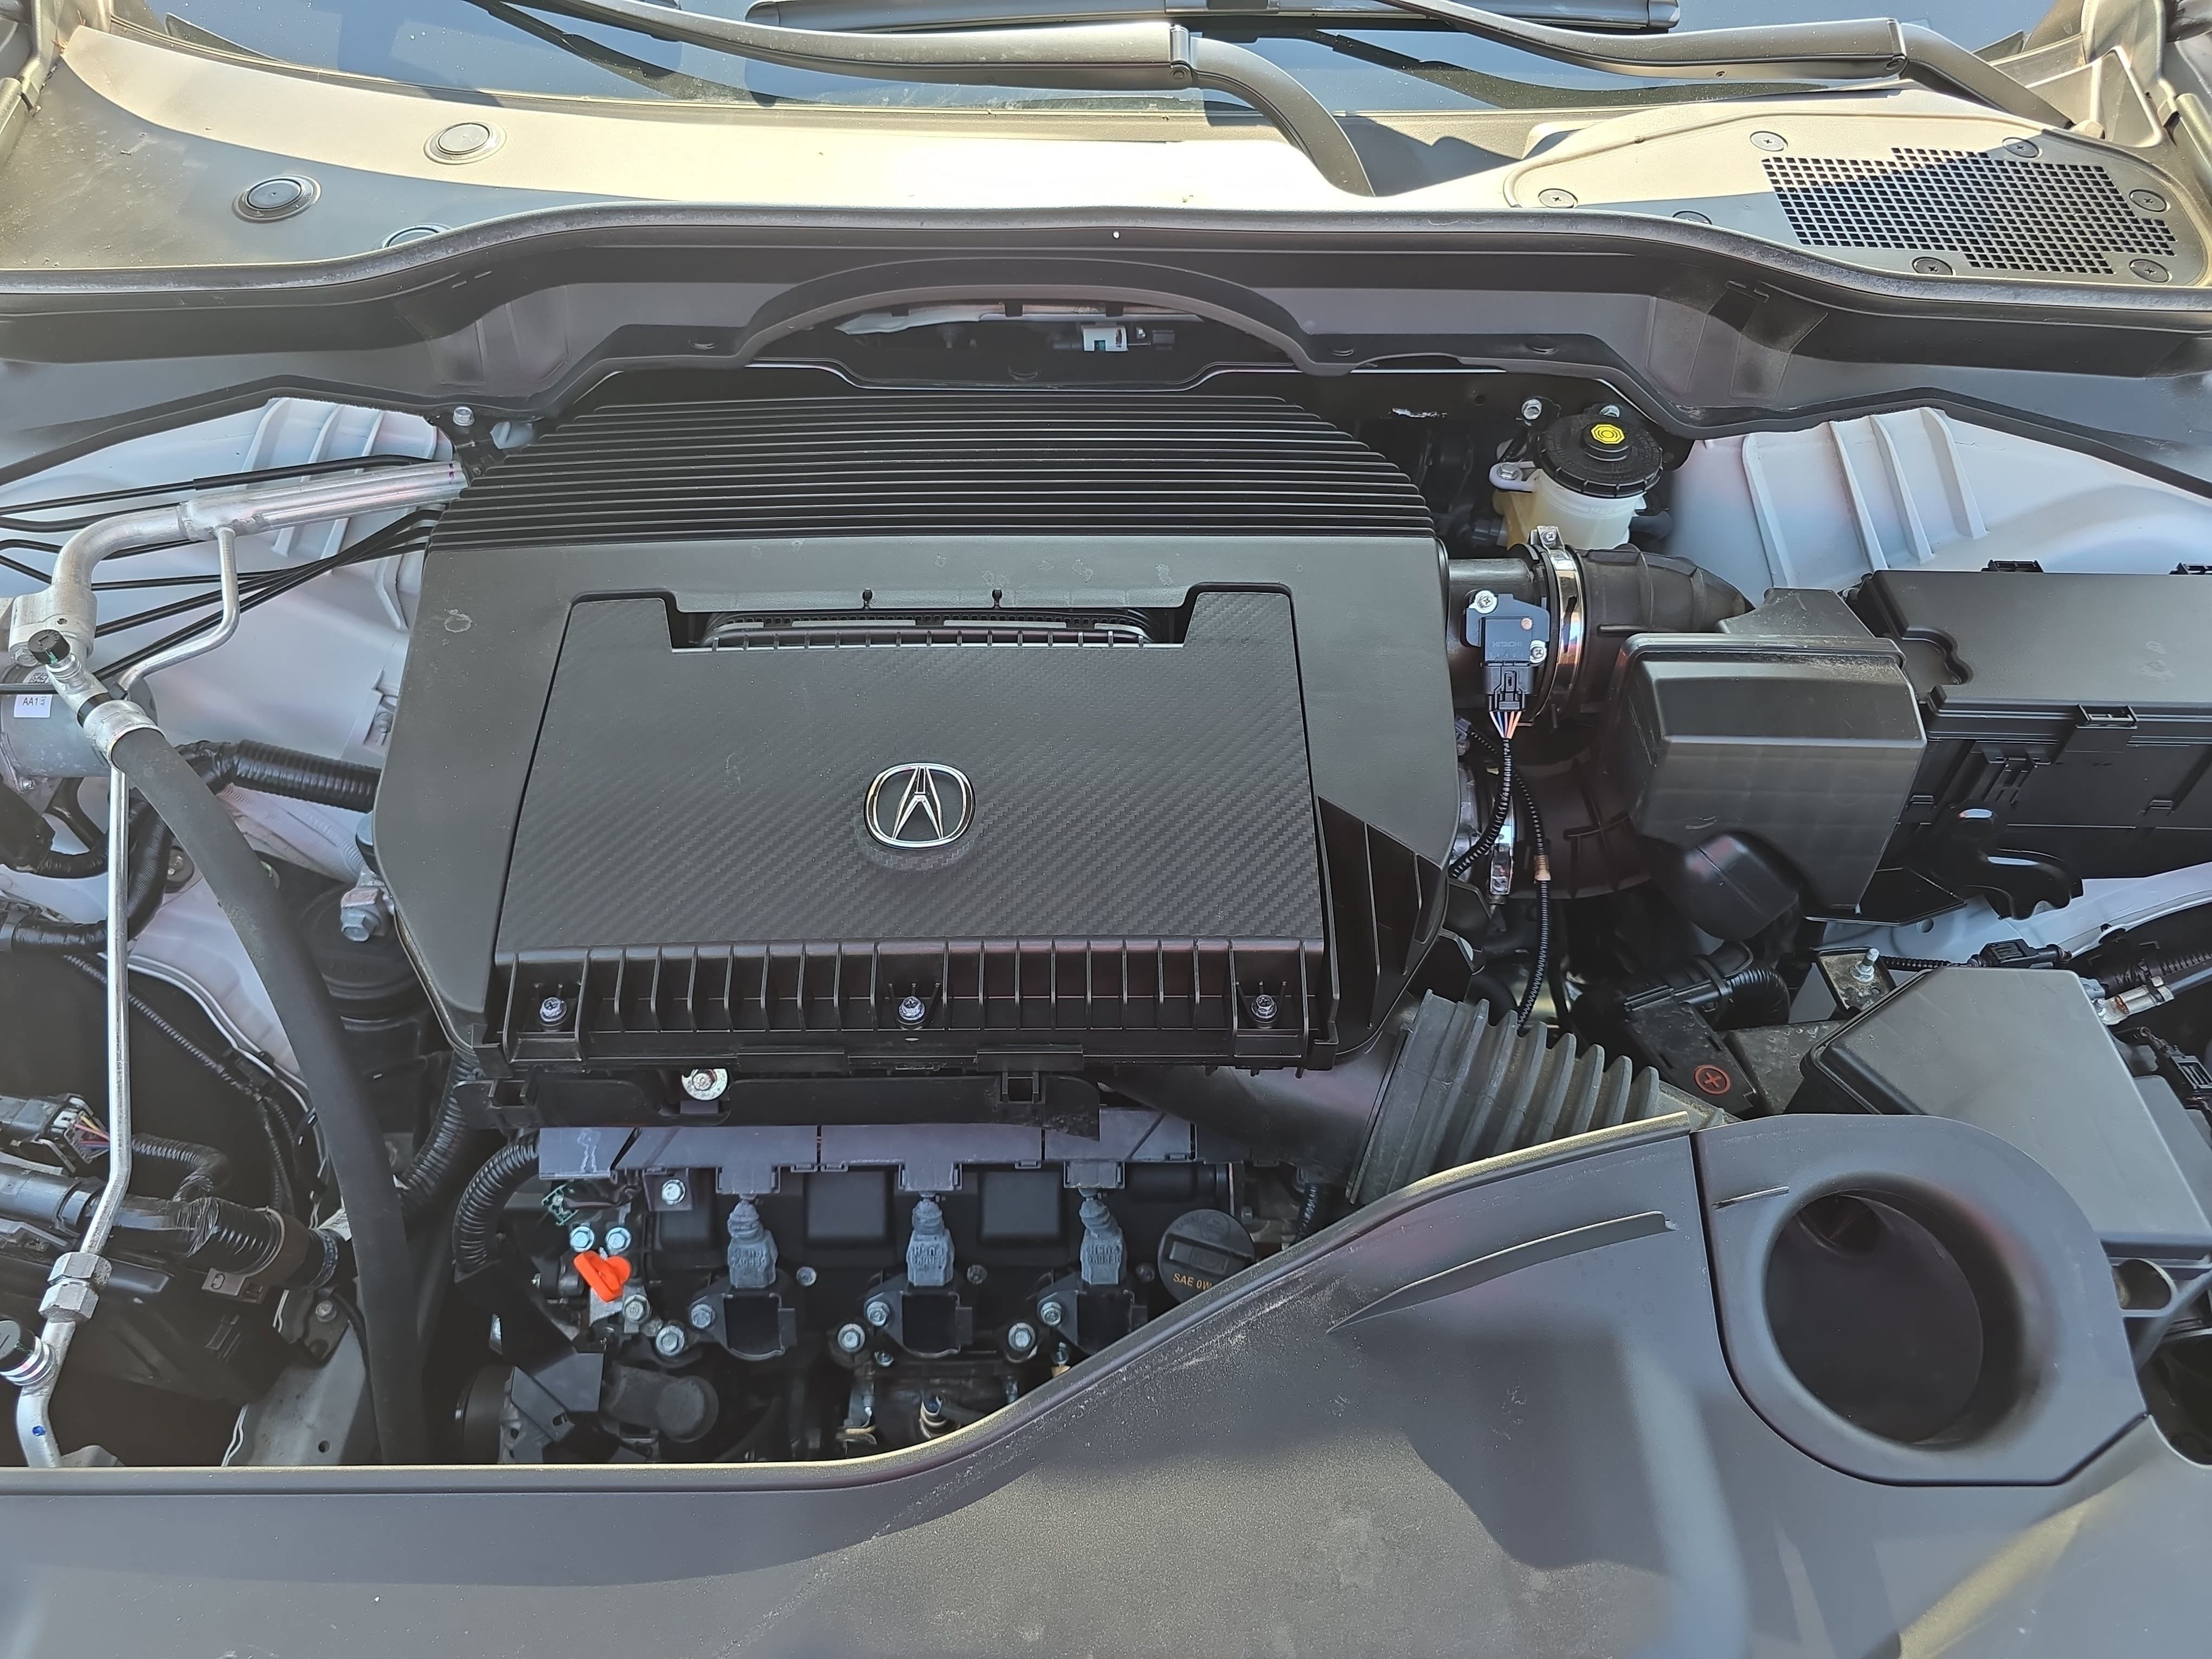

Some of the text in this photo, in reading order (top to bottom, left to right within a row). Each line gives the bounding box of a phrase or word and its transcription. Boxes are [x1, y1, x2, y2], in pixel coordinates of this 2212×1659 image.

[22, 697, 38, 705] AA1
[914, 1247, 943, 1255] PUSH
[1090, 1245, 1118, 1254] PUSH
[1173, 1273, 1194, 1287] SAE
